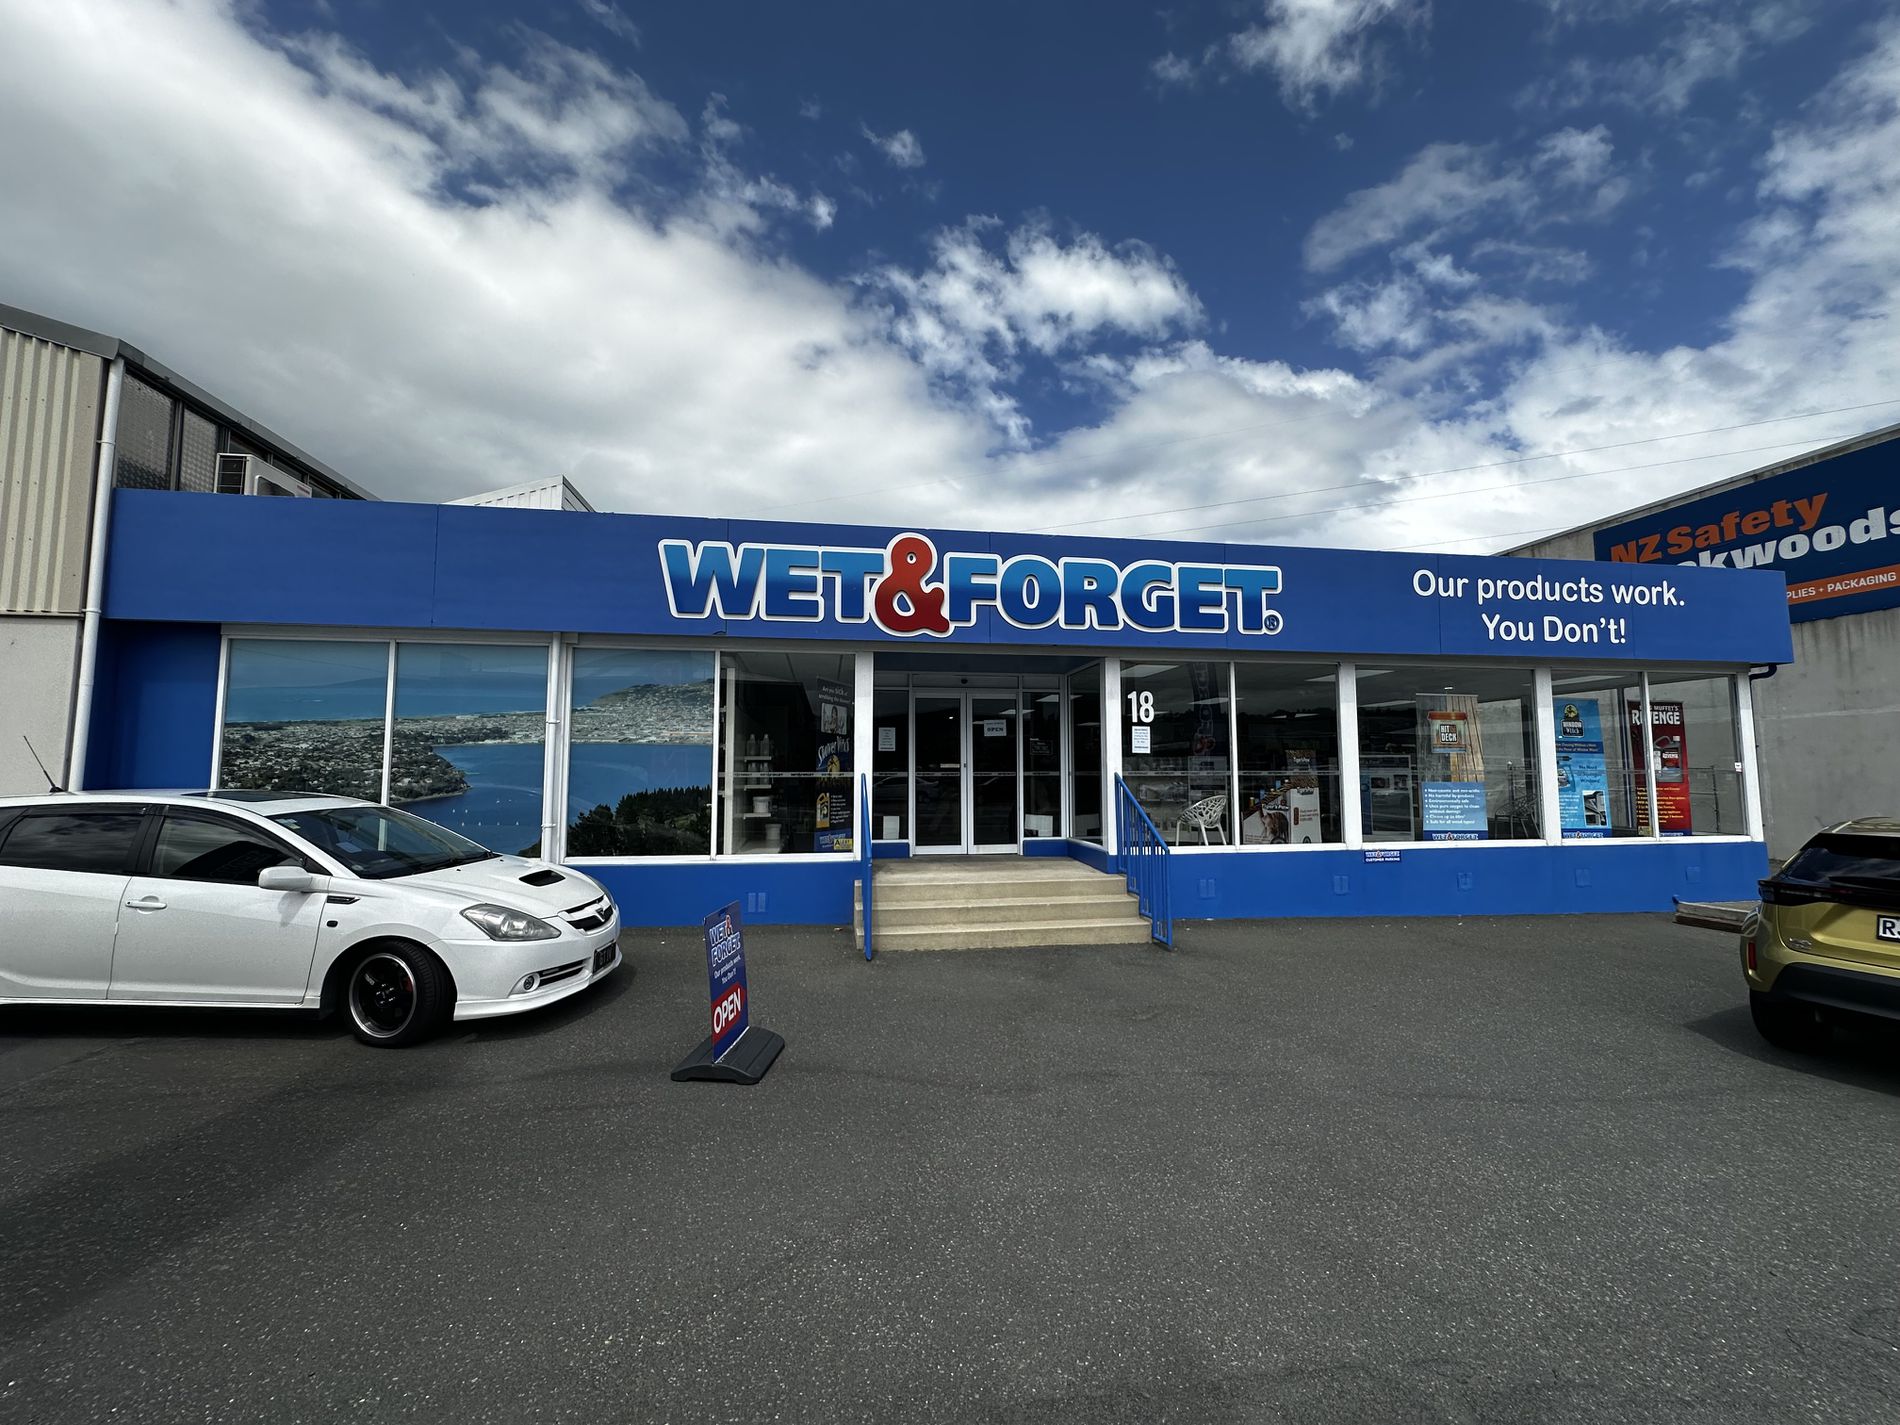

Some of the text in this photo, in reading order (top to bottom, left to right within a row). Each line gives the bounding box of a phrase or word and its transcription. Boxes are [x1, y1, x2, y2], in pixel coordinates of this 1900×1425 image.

[1610, 492, 1829, 563] NZ Safety
[1413, 570, 1685, 606] Our products work.
[1827, 572, 1897, 592] PACKAGING
[1481, 613, 1626, 644] You Don't!
[1127, 690, 1155, 723] 18
[1441, 733, 1457, 742] DECK
[713, 987, 741, 1034] OPEN
